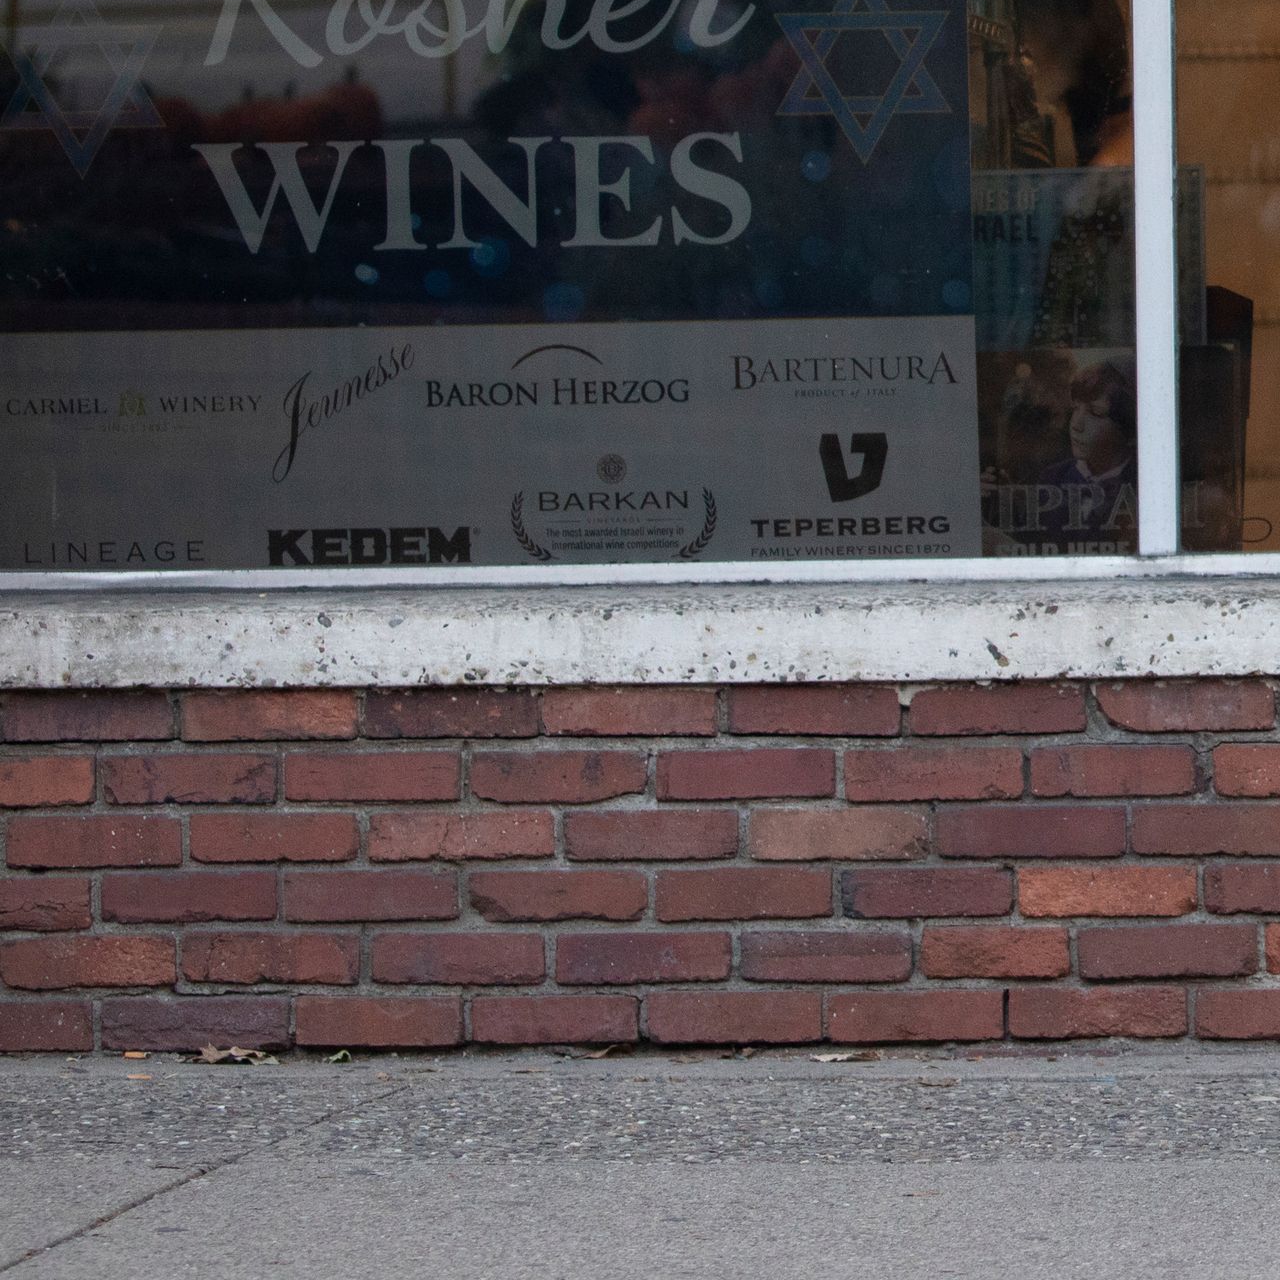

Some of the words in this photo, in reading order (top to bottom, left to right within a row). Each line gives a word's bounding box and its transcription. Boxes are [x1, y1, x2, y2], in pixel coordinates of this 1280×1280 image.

[191, 131, 753, 254] WINES
[974, 215, 1040, 243] RAEL
[731, 352, 958, 391] BARTENURA
[425, 379, 538, 408] BARON
[553, 377, 690, 406] HERZOG
[794, 389, 845, 398] PRODUCT
[867, 388, 897, 397] ITALY
[6, 398, 107, 416] CARMEL
[160, 395, 263, 413] WINERY
[538, 490, 689, 512] BARKAN
[562, 527, 582, 537] most
[585, 526, 619, 537] awarded
[647, 525, 674, 537] winery
[676, 525, 685, 535] in
[750, 516, 951, 538] TEPERBERG
[24, 540, 205, 564] LINEAGE
[267, 527, 471, 565] KEDEM
[605, 539, 625, 550] wine
[626, 538, 680, 550] competitions
[750, 547, 802, 558] FAMILY
[805, 546, 867, 557] WINERY
